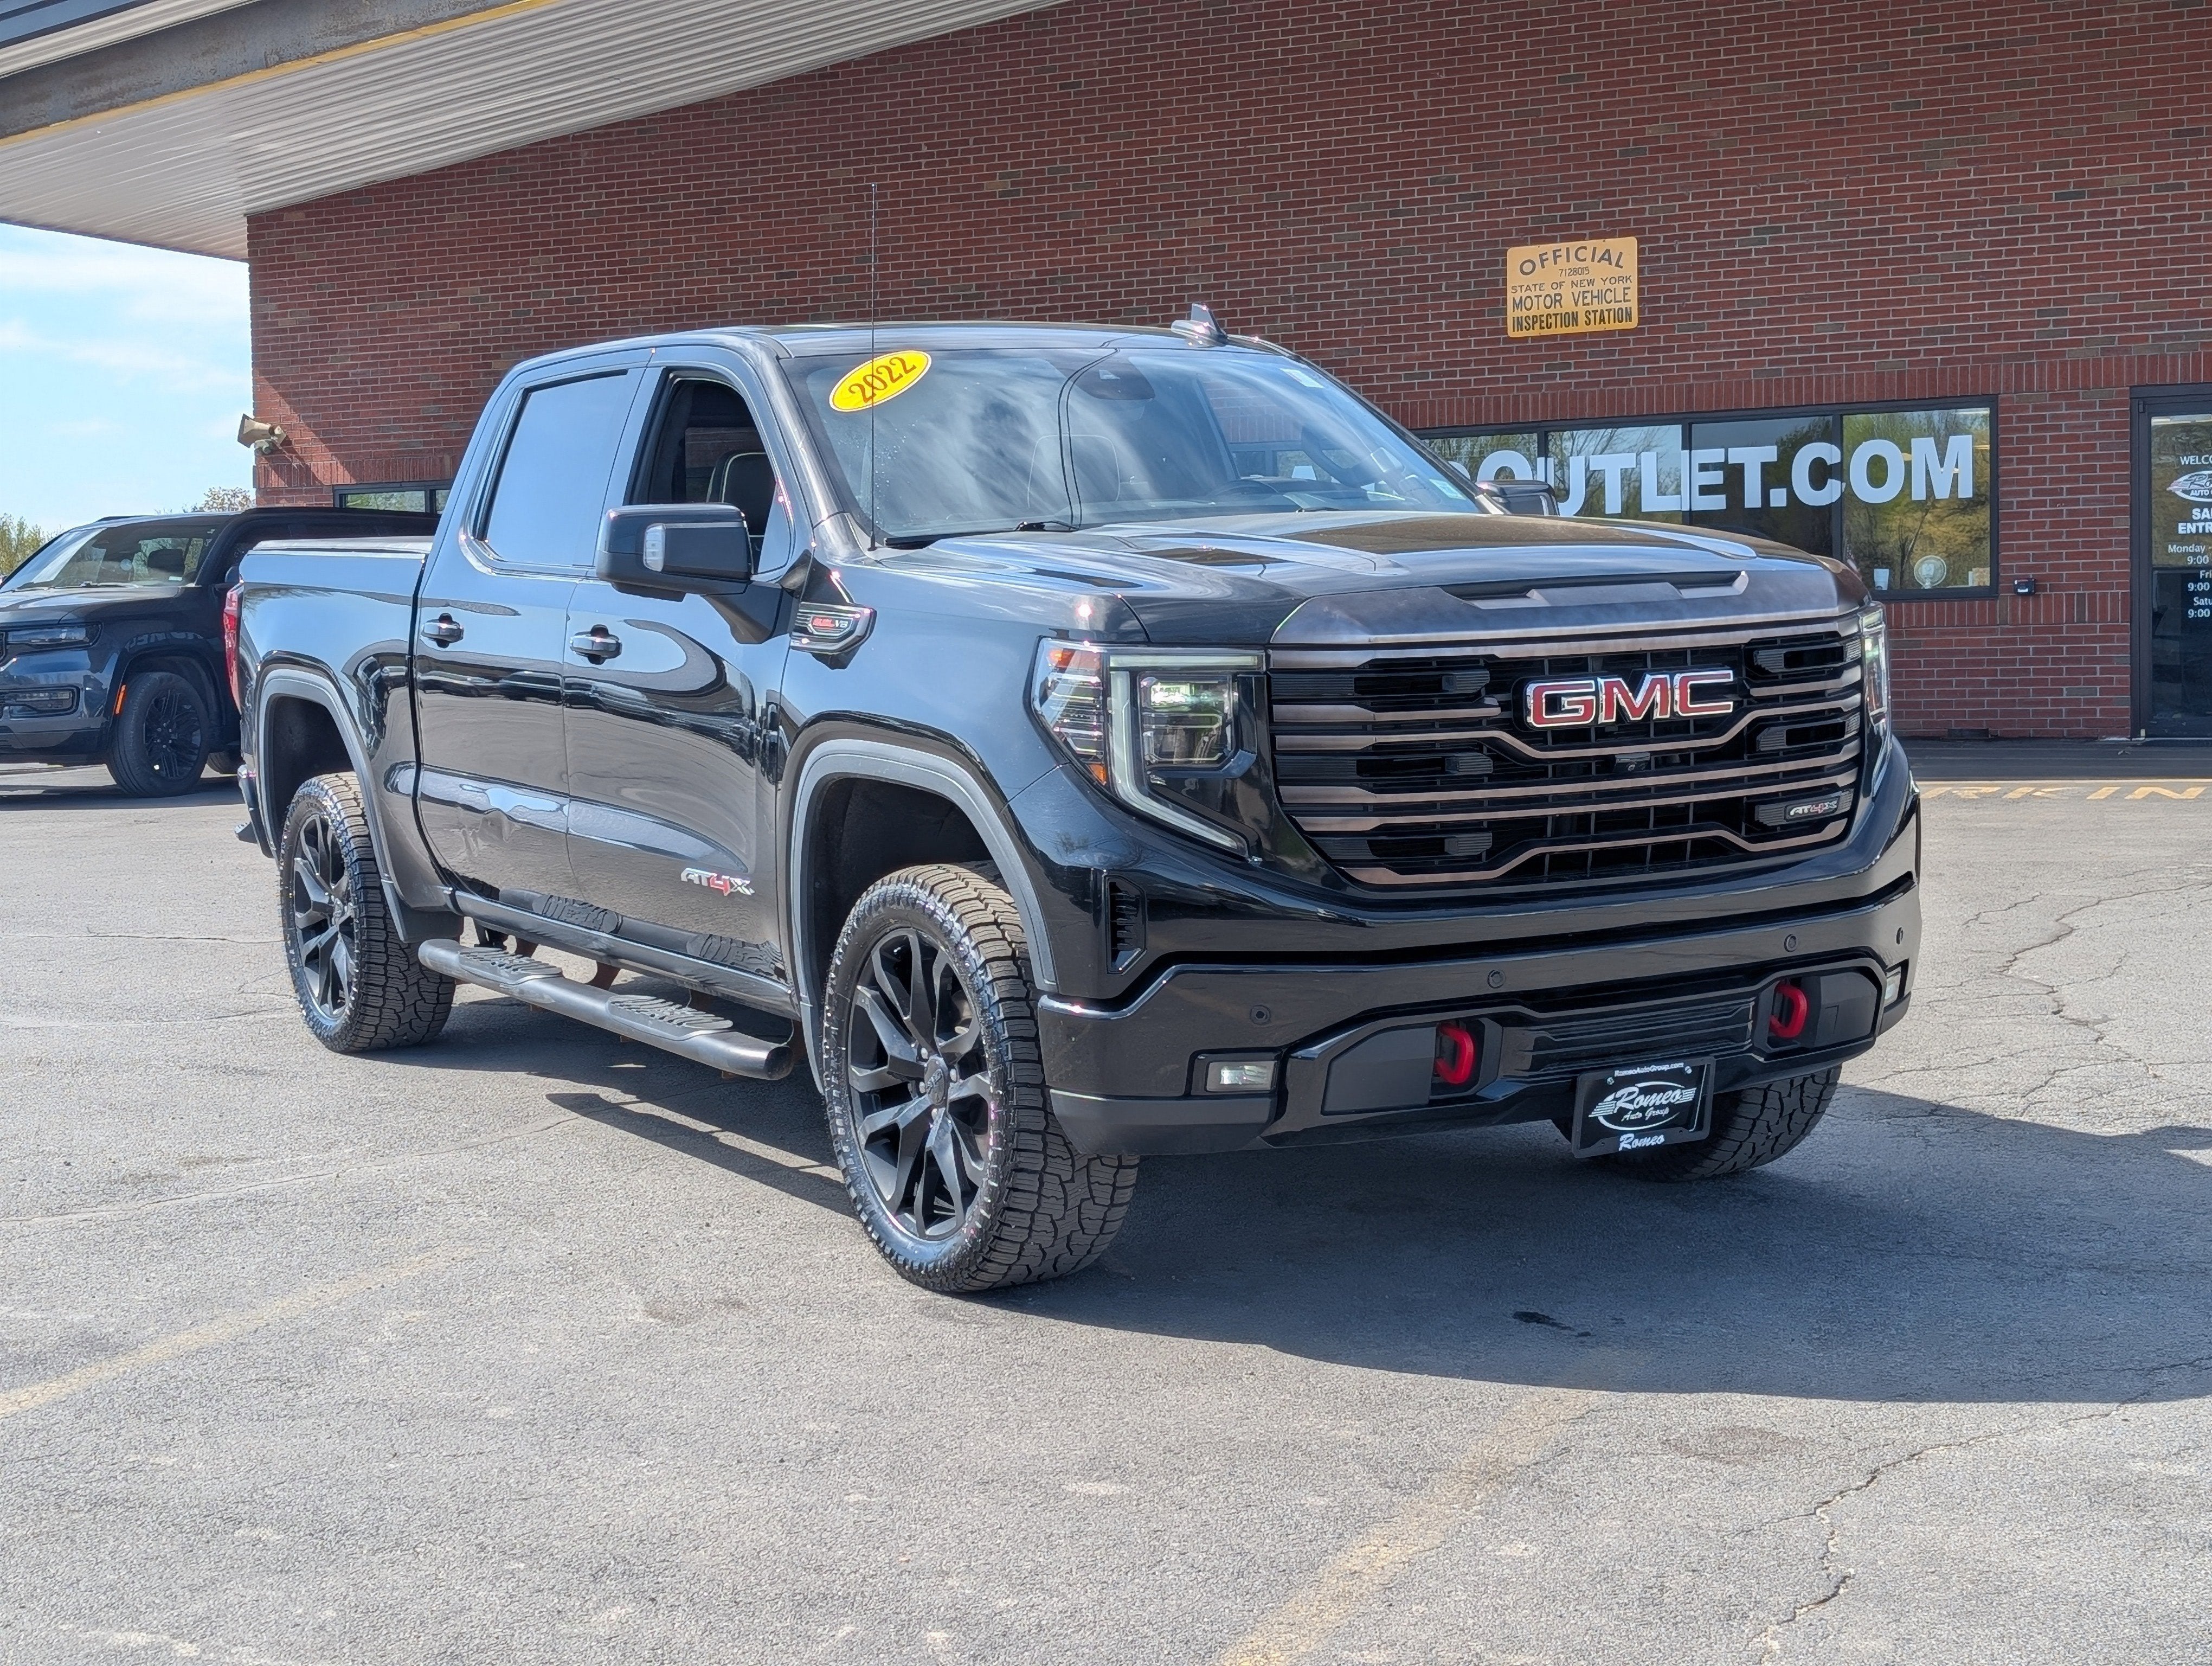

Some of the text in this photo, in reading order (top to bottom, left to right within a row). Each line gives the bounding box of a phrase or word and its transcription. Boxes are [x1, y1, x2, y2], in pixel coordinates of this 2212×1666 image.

[1520, 246, 1623, 275] OFFICIAL
[1511, 275, 1632, 293] STATE OF NEW YORK
[1512, 287, 1631, 312] MOTOR VEHICLE
[1512, 307, 1632, 332] INSPECTION STATION
[848, 357, 917, 403] 2022
[2192, 508, 2212, 520] SA
[2168, 544, 2206, 554] Monday
[2187, 555, 2209, 565] 9:00
[2188, 582, 2210, 591] 9:00
[2188, 608, 2210, 618] 9:00
[1526, 669, 1734, 728] GMC
[1790, 800, 1837, 816] AT4X
[680, 868, 755, 896] AT4X
[1613, 1086, 1682, 1113] Romeo
[1621, 1107, 1669, 1122] Auto Group
[1618, 1133, 1665, 1151] Romeo
